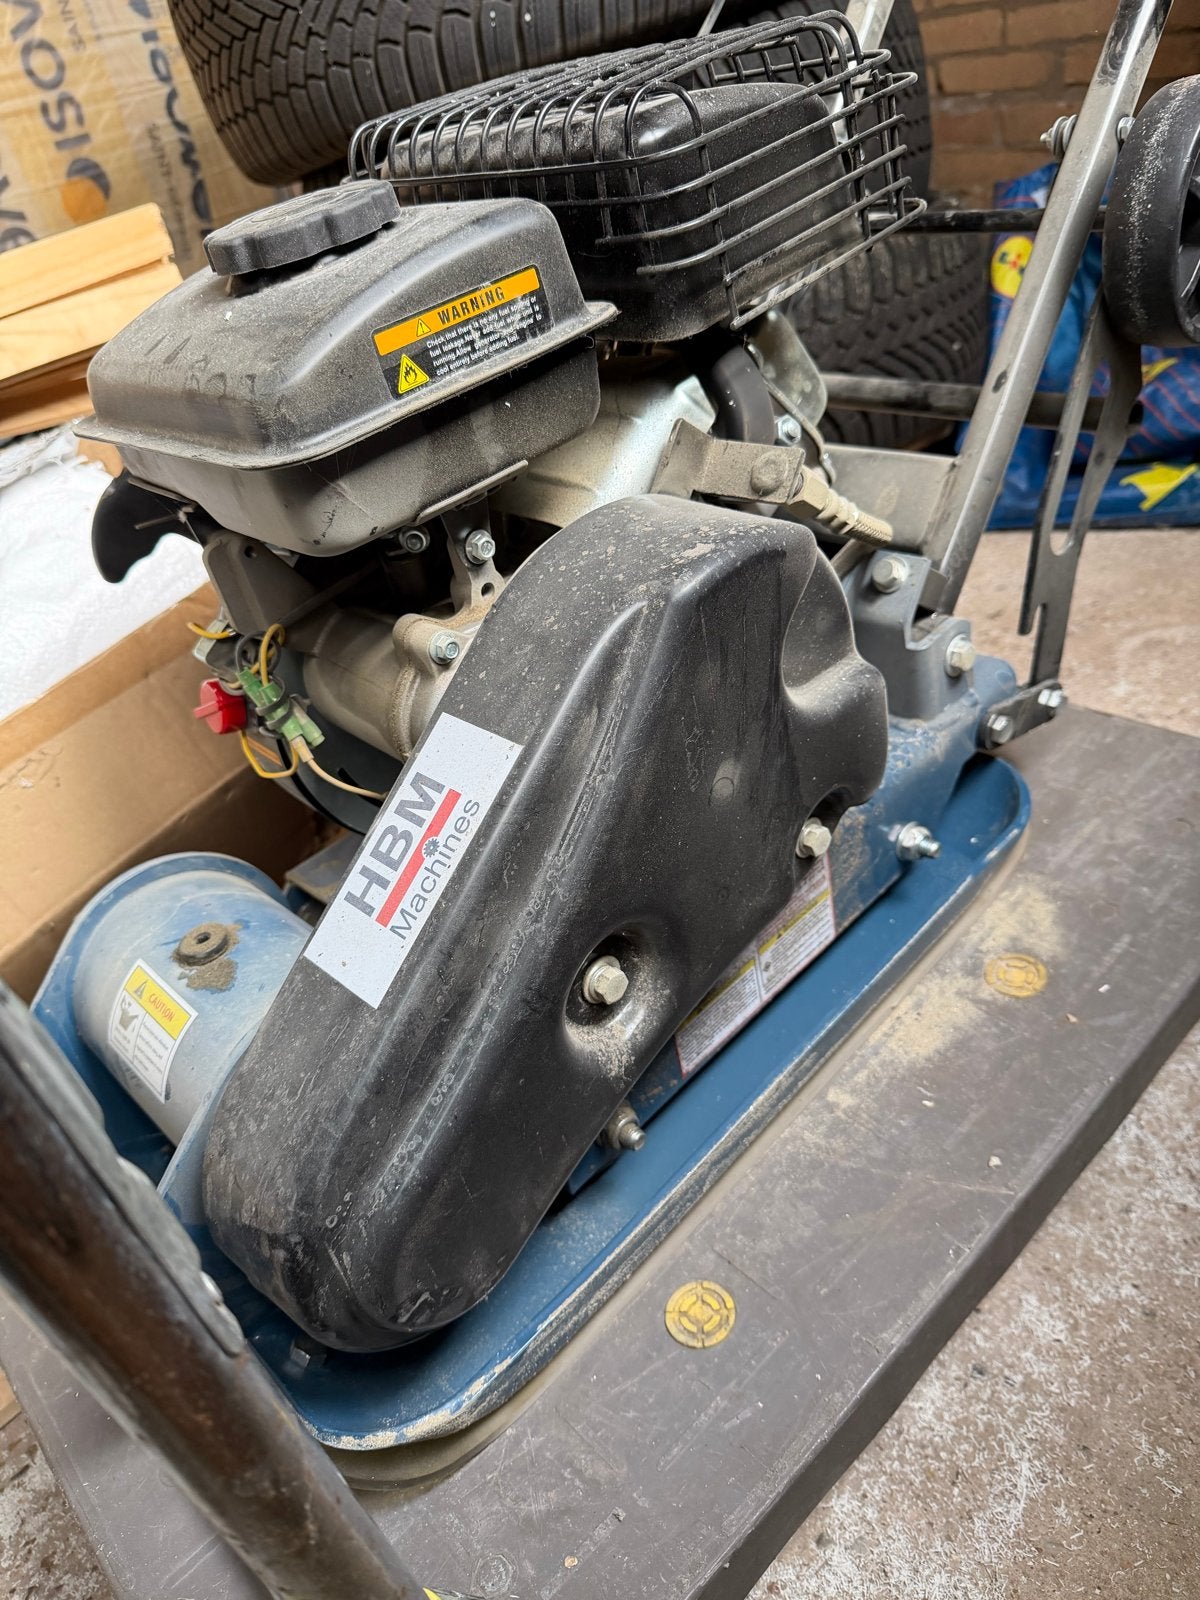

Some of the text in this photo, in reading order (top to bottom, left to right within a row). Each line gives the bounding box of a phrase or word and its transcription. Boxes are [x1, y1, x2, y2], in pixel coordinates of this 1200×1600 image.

[438, 287, 504, 324] WARNING
[427, 337, 445, 347] Check
[445, 330, 457, 339] that
[458, 323, 472, 333] there
[498, 308, 510, 316] fuel
[429, 348, 441, 357] fuel
[435, 366, 449, 376] cool
[344, 772, 446, 917] HBM
[389, 798, 480, 940] Machines
[148, 993, 175, 1022] CAUTION
